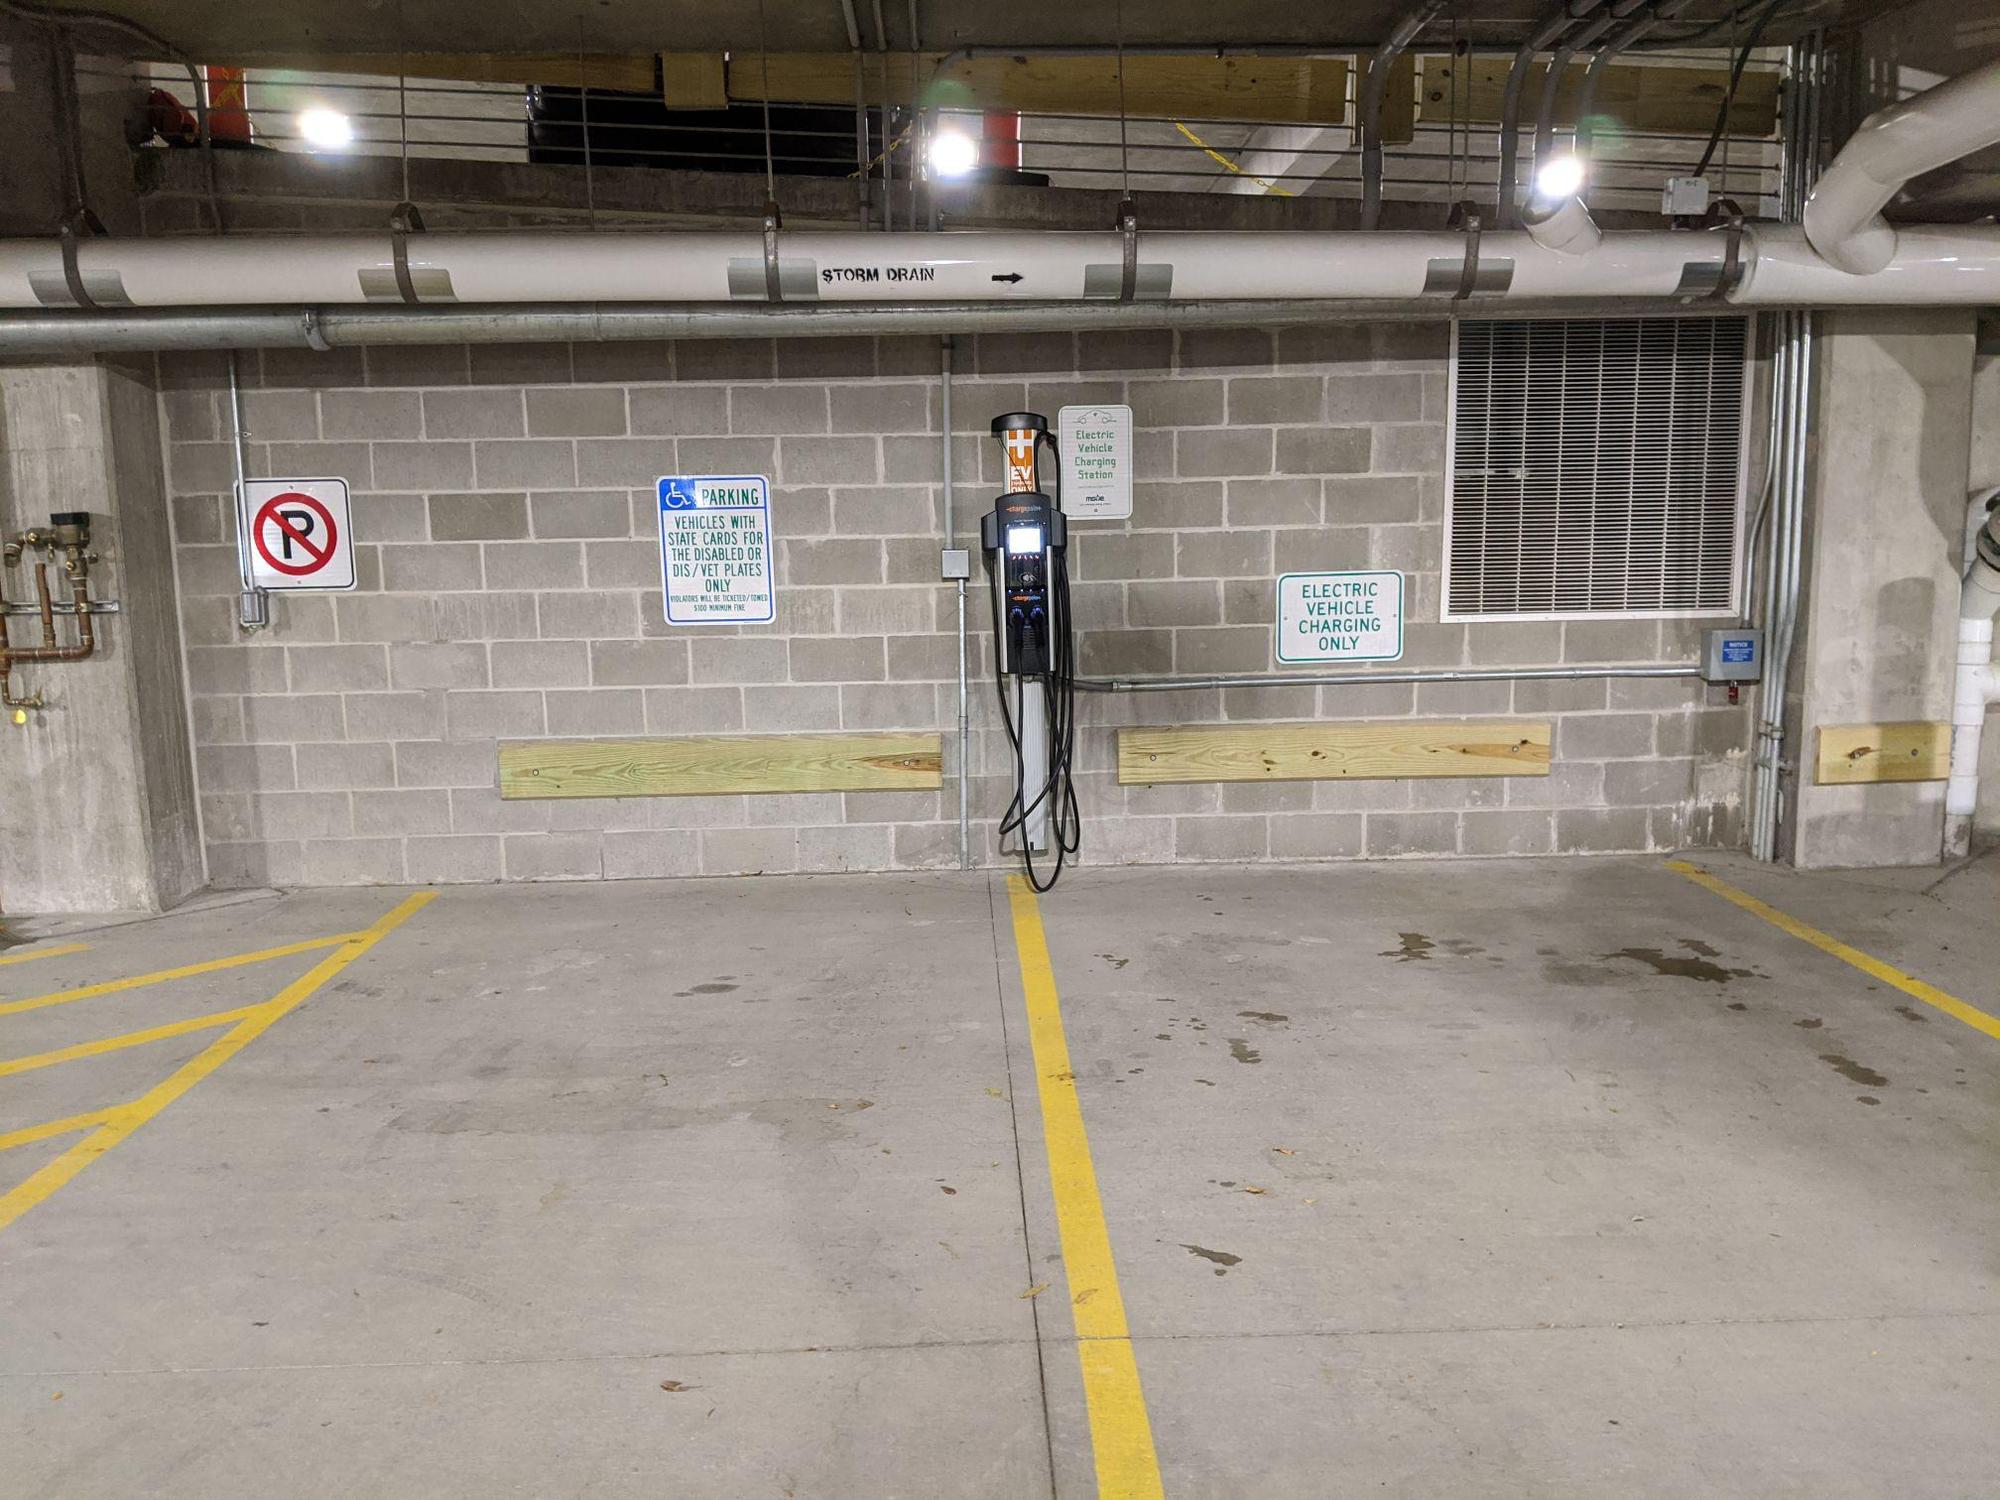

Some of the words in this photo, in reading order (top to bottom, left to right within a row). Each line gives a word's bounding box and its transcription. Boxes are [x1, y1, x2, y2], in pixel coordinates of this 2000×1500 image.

[822, 268, 878, 283] STORM
[887, 268, 935, 281] DRAIN
[1076, 430, 1114, 439] Electric
[1078, 444, 1113, 452] Vehicle
[1075, 457, 1116, 468] Charging
[1010, 466, 1032, 480] EV
[1078, 470, 1113, 480] Station
[702, 488, 758, 505] PARKING
[674, 516, 725, 529] VEHICLES
[731, 516, 755, 528] WITH
[668, 532, 697, 545] STATE
[703, 532, 737, 545] CARDS
[744, 532, 763, 544] FOR
[672, 549, 690, 561] THE
[695, 548, 743, 561] DISABLED
[748, 548, 761, 560] OR
[673, 564, 718, 577] DIS/VET
[725, 563, 761, 577] PLATES
[706, 579, 731, 592] ONLY
[1302, 582, 1378, 598] ELECTRIC
[1306, 601, 1374, 615] VEHICLE
[1299, 618, 1381, 634] CHARGING
[1319, 636, 1360, 650] ONLY
